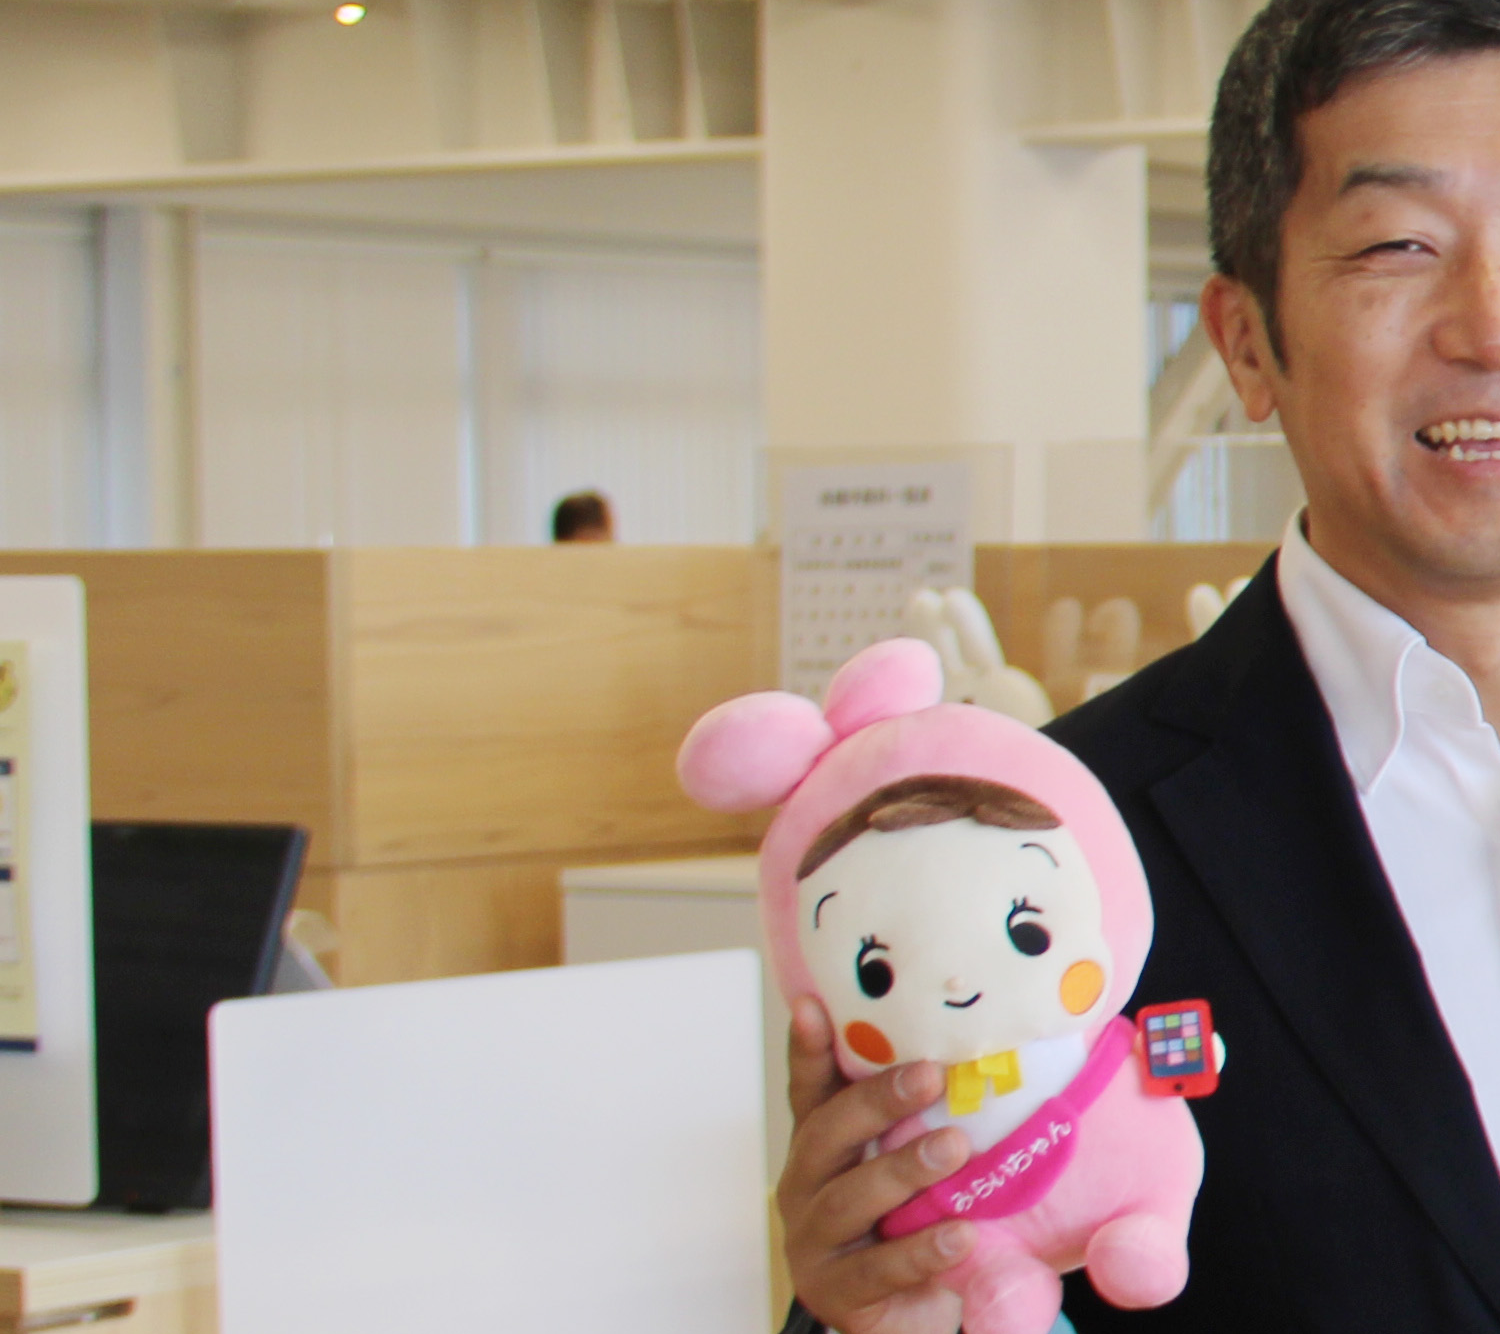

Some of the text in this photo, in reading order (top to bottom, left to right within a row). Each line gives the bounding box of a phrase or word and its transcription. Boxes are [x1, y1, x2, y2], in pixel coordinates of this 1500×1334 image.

[951, 1120, 1071, 1212] みらいちゃん
